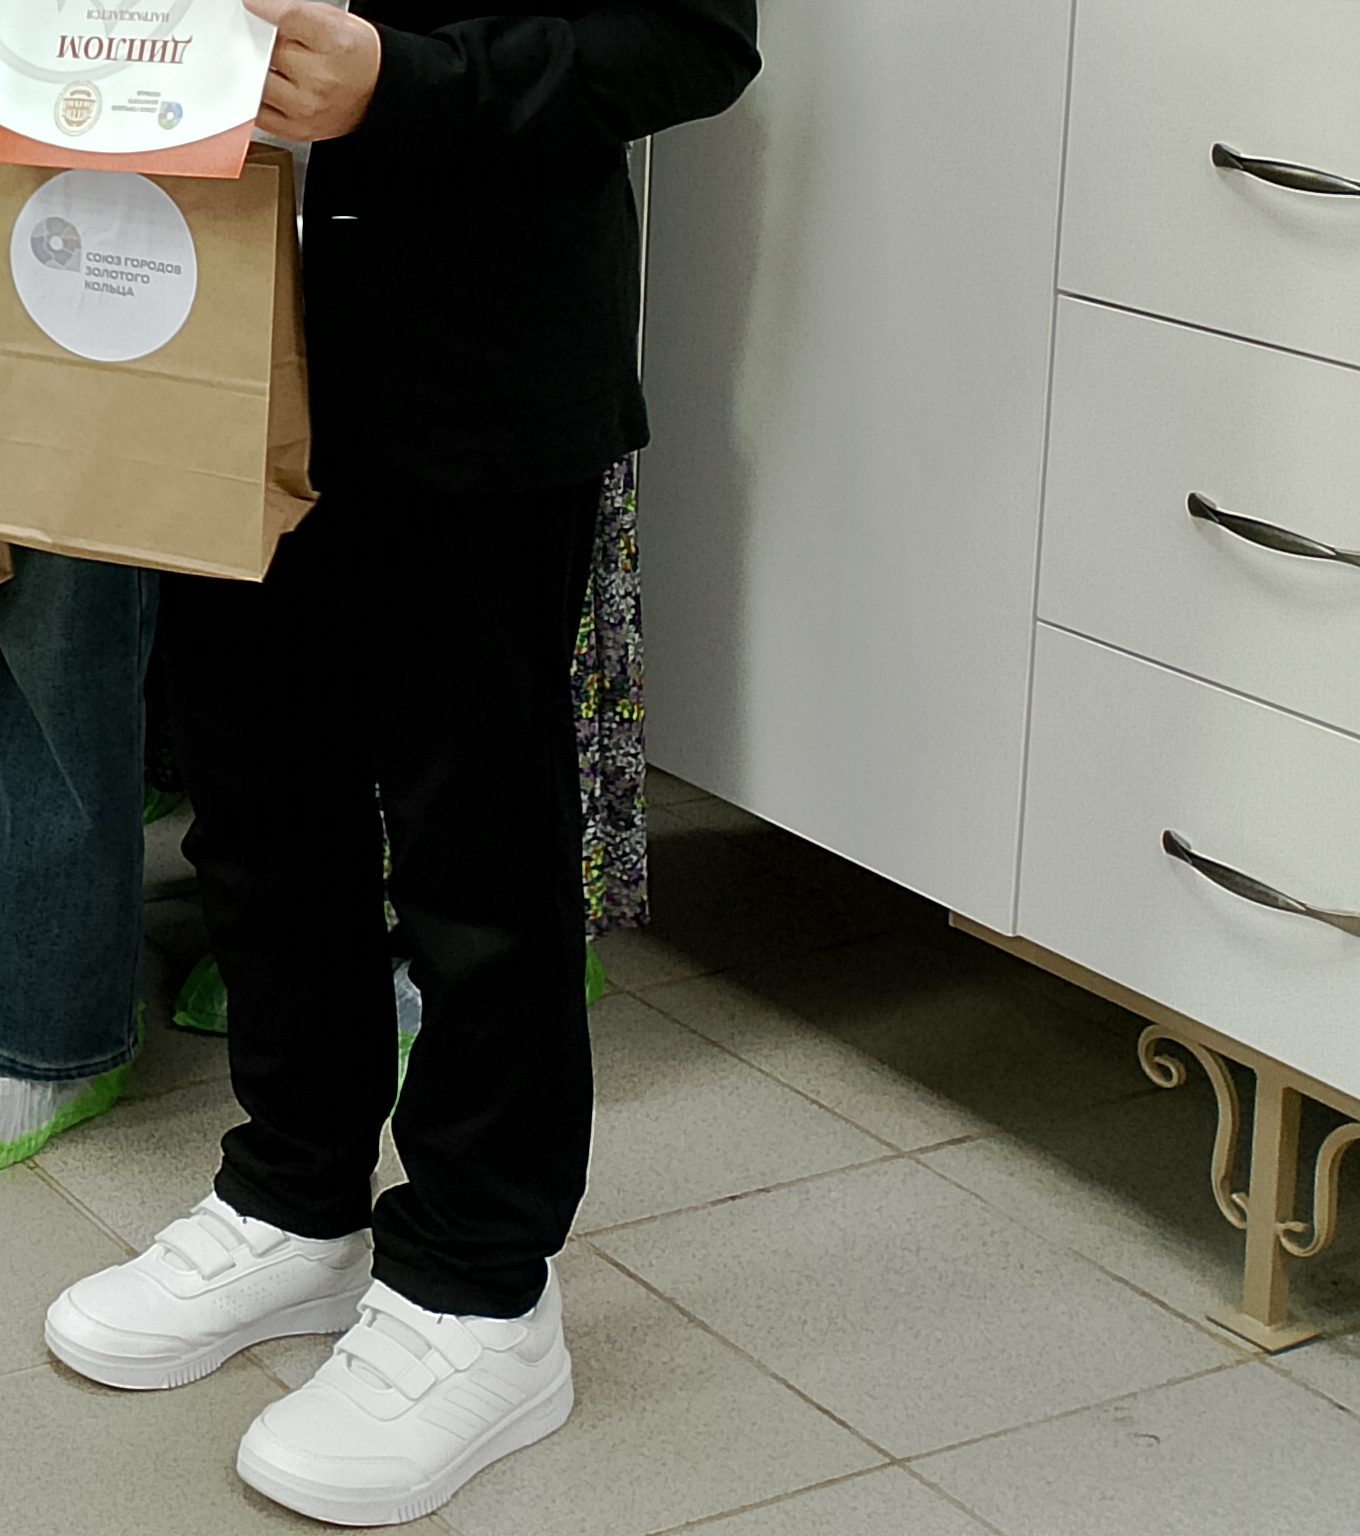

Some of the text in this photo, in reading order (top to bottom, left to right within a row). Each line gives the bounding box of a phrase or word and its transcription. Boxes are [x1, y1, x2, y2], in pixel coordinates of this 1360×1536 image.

[86, 9, 170, 23] НАГРАЖДАЕТСЯ
[56, 35, 193, 65] ДИПЛОМ
[85, 251, 182, 275] СОЮЗ ГОРОДОВ
[85, 266, 150, 285] ЗОЛОТОГО
[84, 280, 135, 297] КОЛЬЦА
